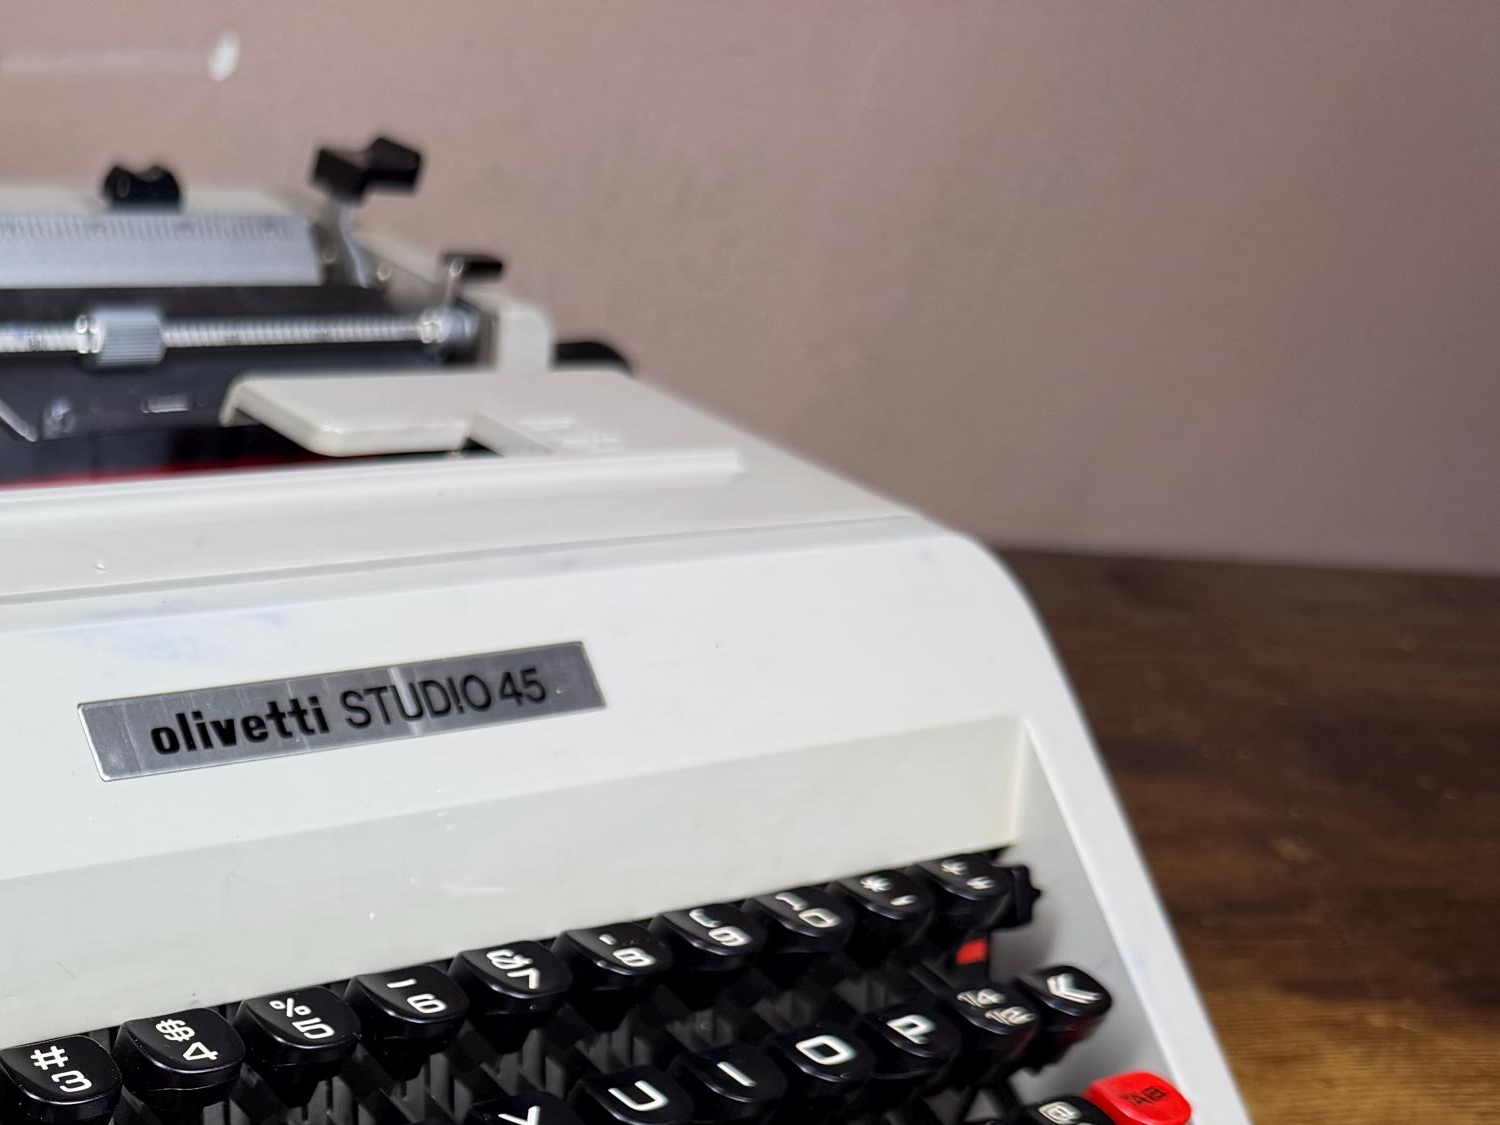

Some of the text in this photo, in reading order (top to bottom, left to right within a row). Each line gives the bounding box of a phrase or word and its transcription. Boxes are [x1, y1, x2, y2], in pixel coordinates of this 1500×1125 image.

[150, 667, 547, 755] olivetti STUDIO 45
[708, 925, 751, 947] 9
[613, 947, 656, 967] 8
[506, 966, 541, 989] 7
[269, 997, 310, 1018] %
[406, 993, 447, 1014] 6
[155, 1018, 196, 1043] $
[291, 1018, 335, 1040] 5
[886, 1014, 935, 1044] P
[30, 1045, 70, 1072] #
[182, 1041, 219, 1062] 4
[795, 1035, 856, 1065] O
[50, 1068, 93, 1093] 3
[716, 1061, 756, 1086] I
[607, 1080, 668, 1111] U
